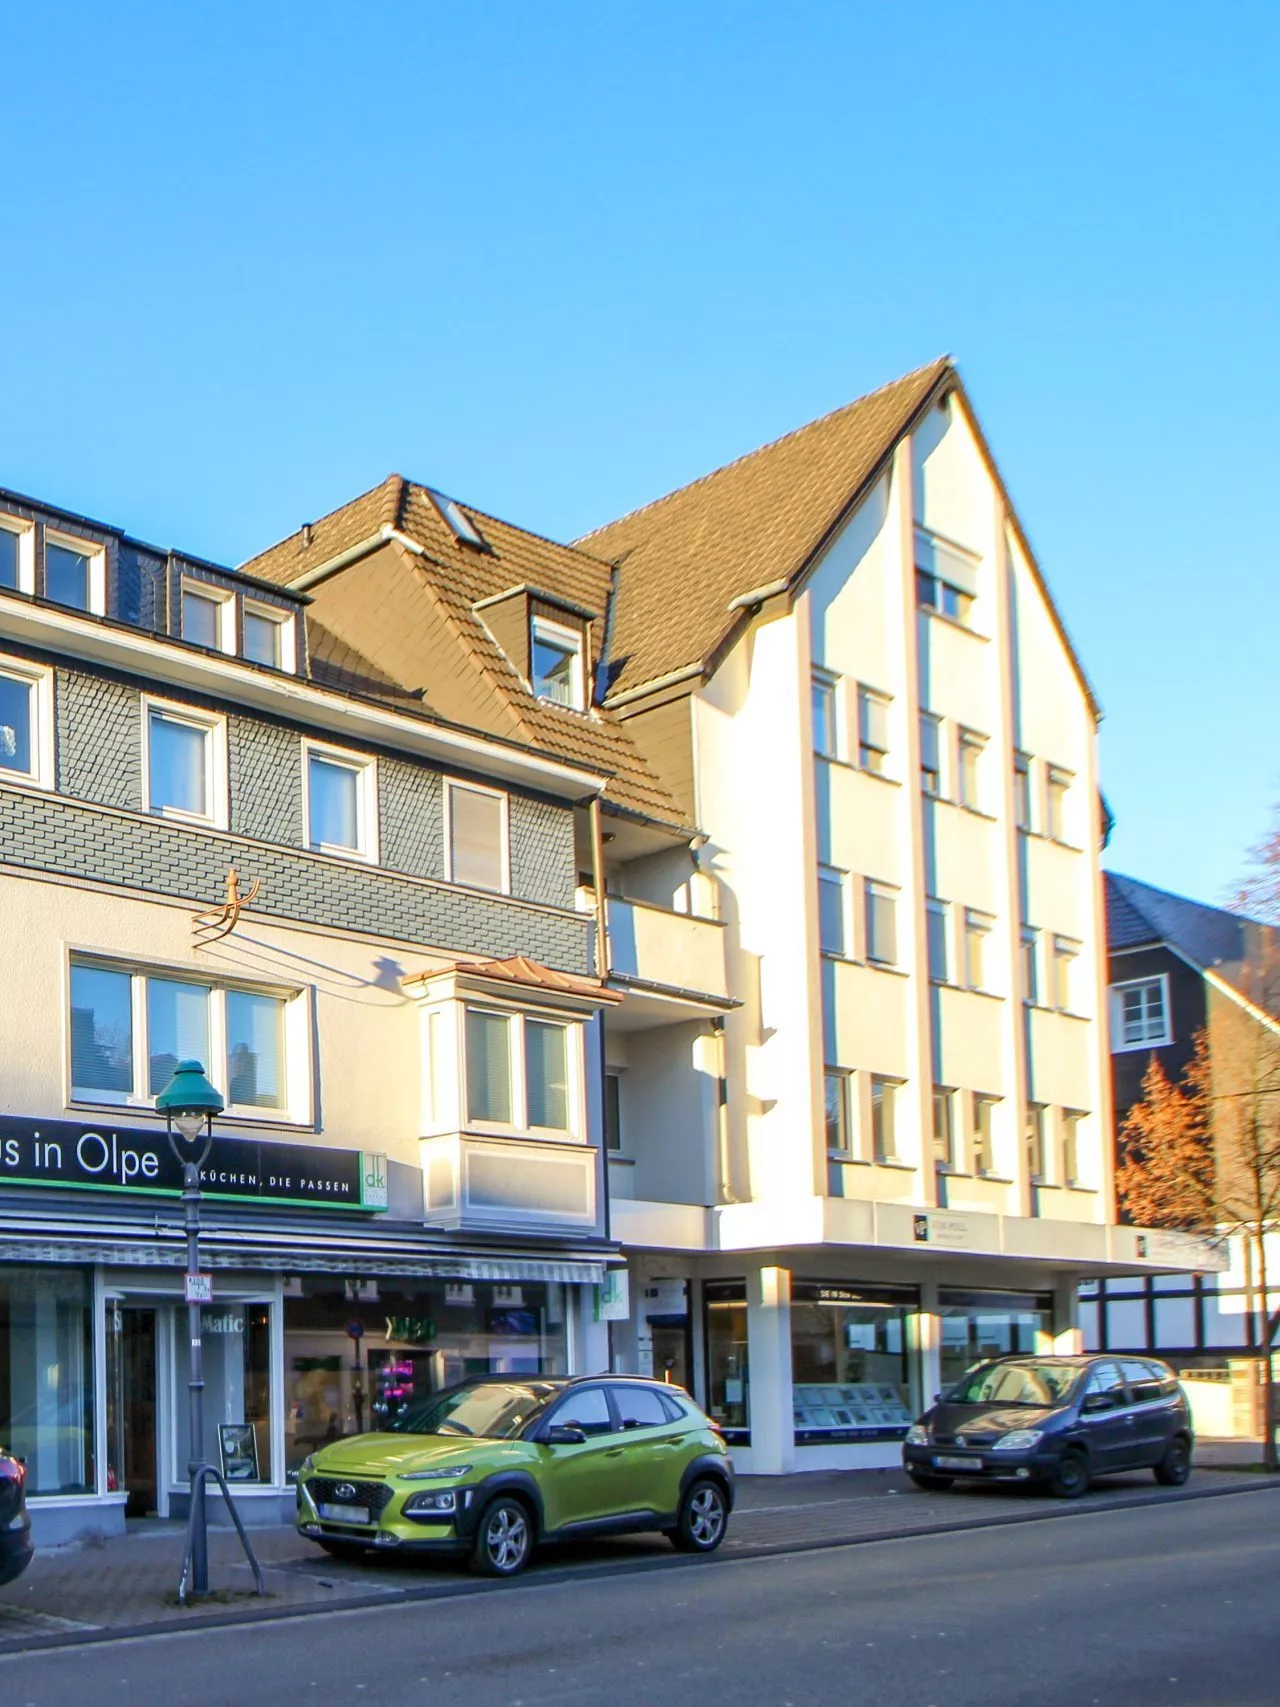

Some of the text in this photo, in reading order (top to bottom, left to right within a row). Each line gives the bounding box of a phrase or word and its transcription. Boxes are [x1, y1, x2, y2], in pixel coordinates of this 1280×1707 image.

[33, 1131, 62, 1169] in
[76, 1132, 159, 1185] Olpe
[270, 1176, 291, 1188] DIE
[300, 1179, 350, 1193] PASSEN
